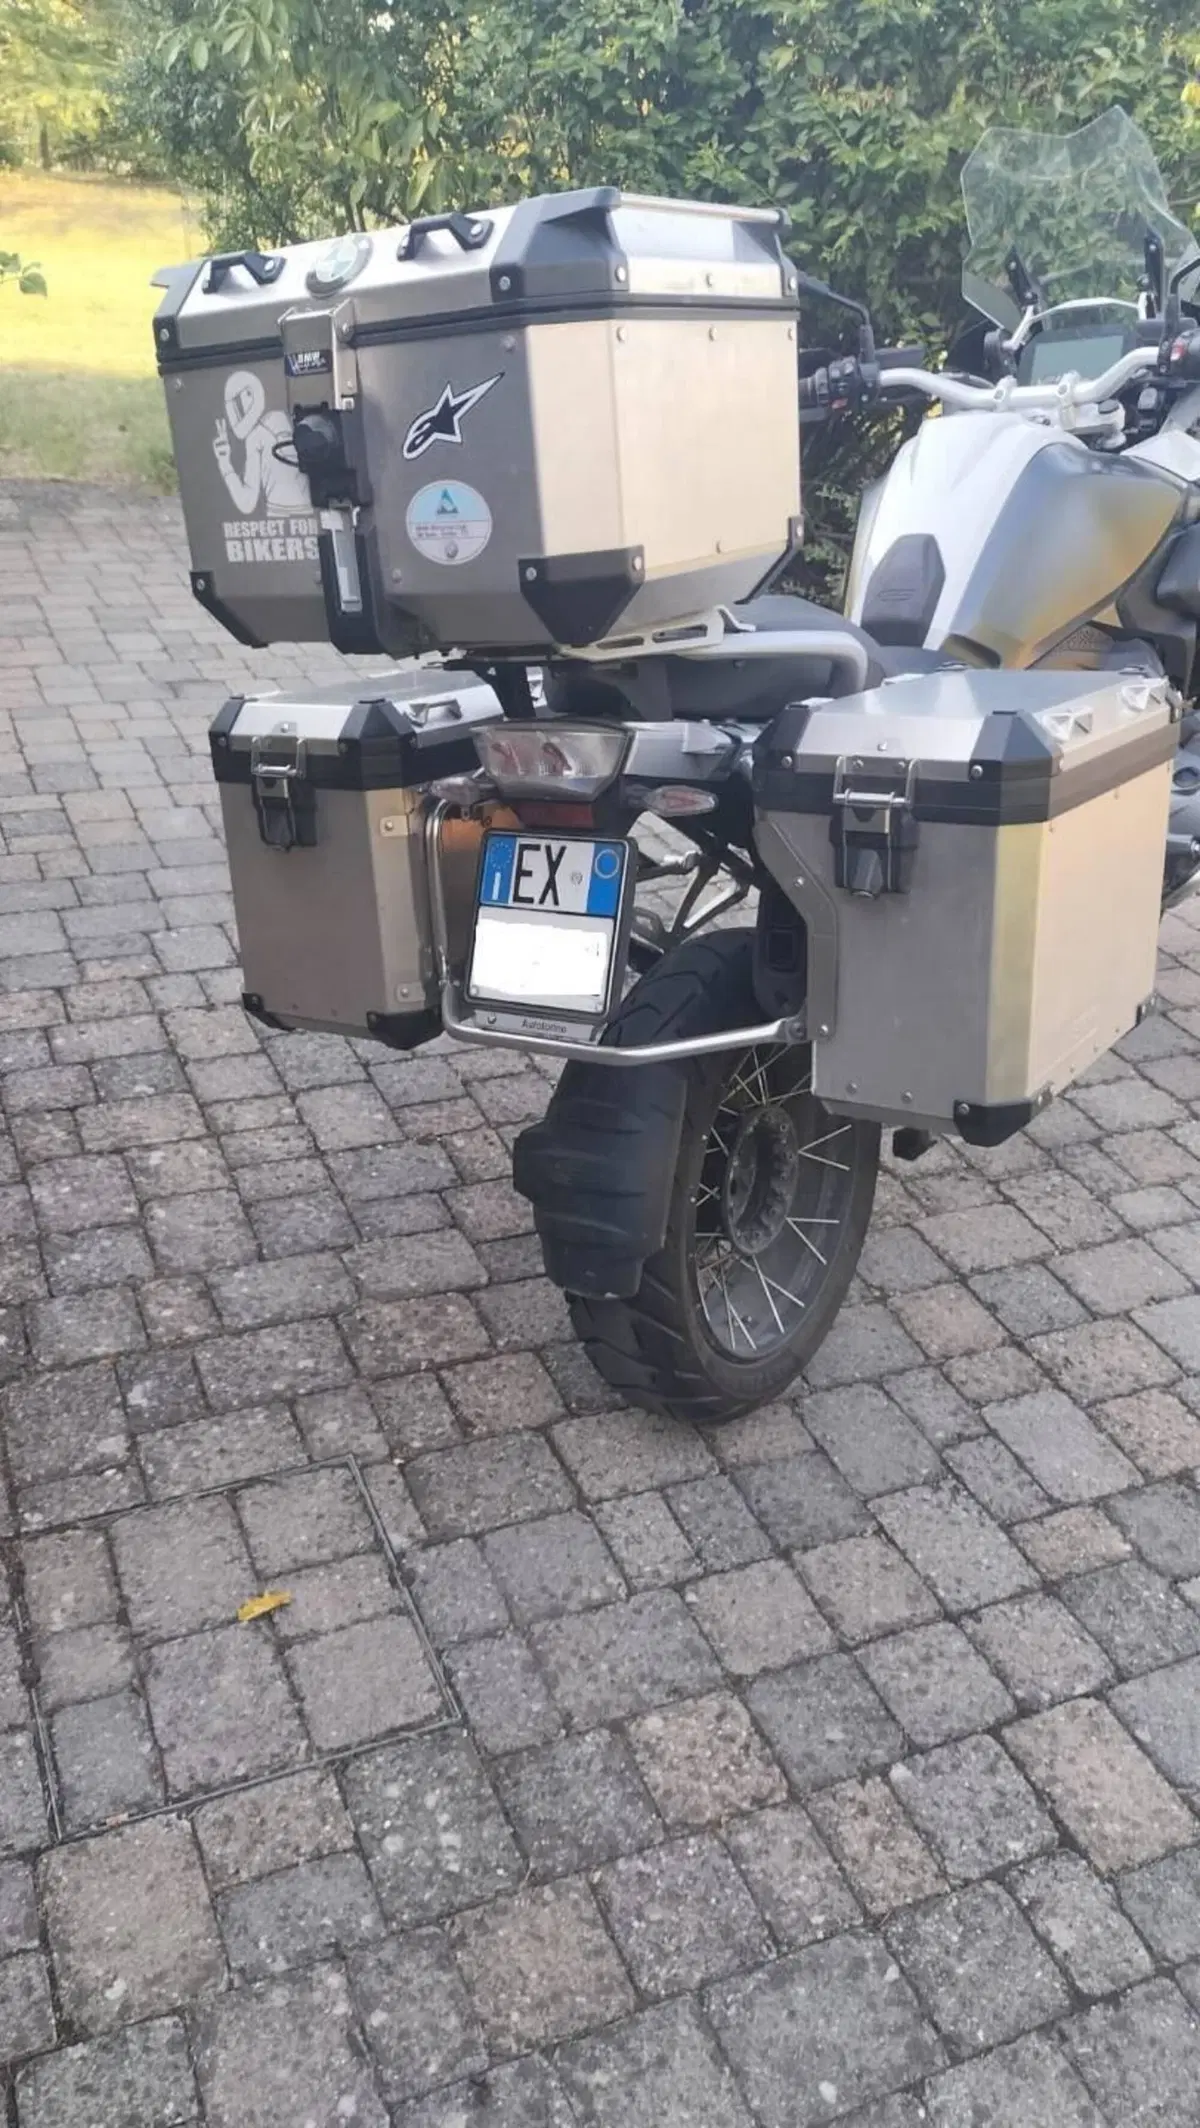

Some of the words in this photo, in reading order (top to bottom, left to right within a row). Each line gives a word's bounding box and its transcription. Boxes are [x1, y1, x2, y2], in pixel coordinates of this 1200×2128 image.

[223, 519, 285, 538] RESPECT
[289, 517, 319, 536] FOR
[226, 536, 320, 562] BIKERS
[513, 843, 567, 906] EX
